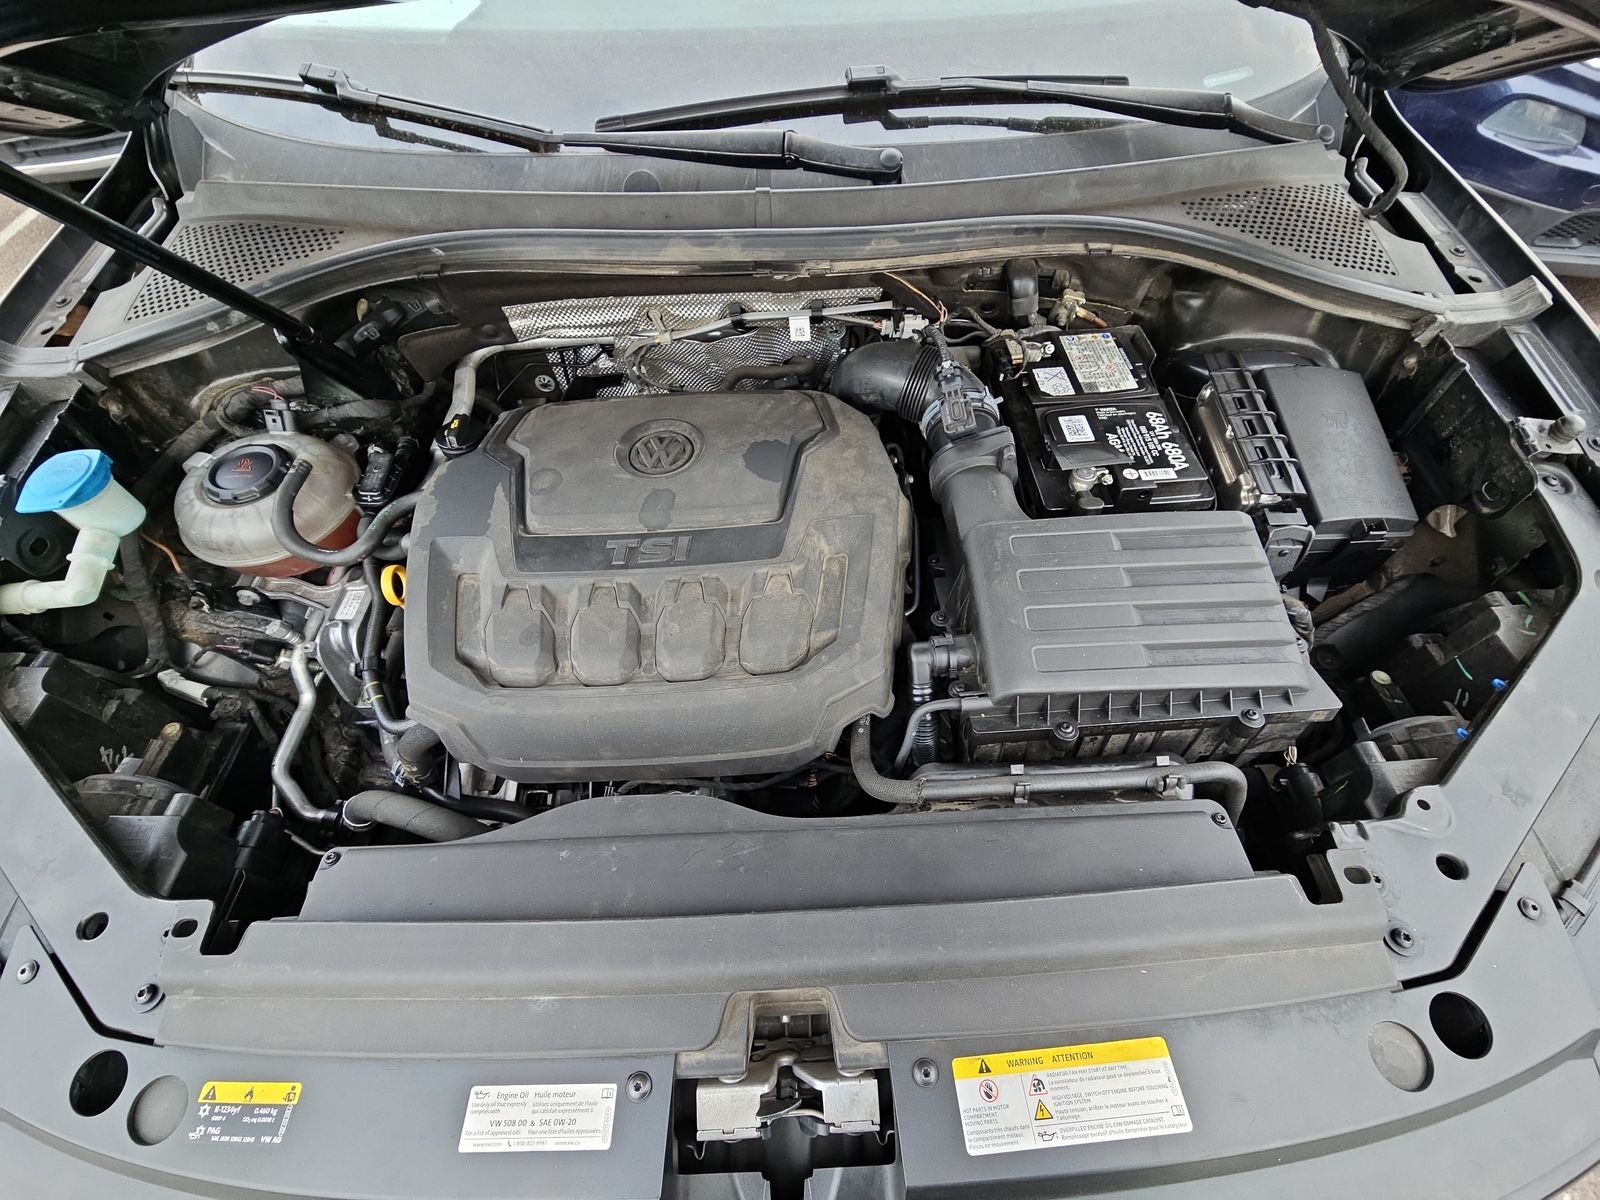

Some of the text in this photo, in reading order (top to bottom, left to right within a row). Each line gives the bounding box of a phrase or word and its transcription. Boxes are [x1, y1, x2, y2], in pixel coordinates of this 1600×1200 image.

[1146, 411, 1172, 440] 68Ah
[1162, 442, 1190, 470] 680A
[605, 536, 692, 565] TSI
[1006, 1051, 1093, 1067] WARNING ATTENTION
[496, 1091, 519, 1101] Engine
[214, 1105, 242, 1116] R-1234yf
[1058, 1125, 1086, 1133] OVERFILLED
